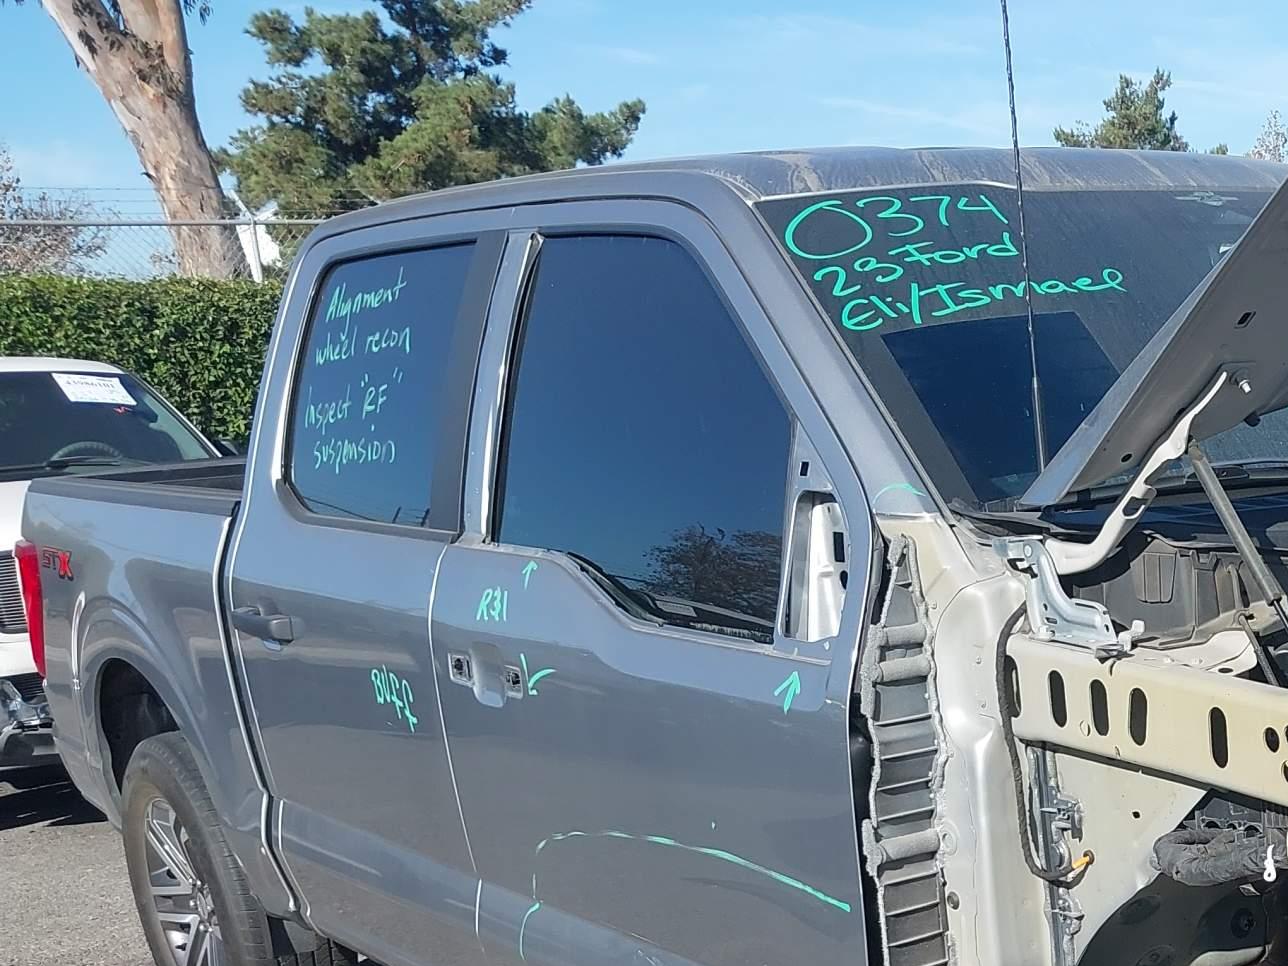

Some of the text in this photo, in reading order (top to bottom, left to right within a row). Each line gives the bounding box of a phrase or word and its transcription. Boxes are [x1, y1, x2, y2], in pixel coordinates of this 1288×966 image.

[785, 194, 1009, 259] 0374
[814, 232, 1019, 297] 23 Ford
[325, 266, 408, 340] Alignment
[315, 325, 412, 366] wheel recon
[313, 427, 396, 475] suspension
[41, 545, 74, 582] STX
